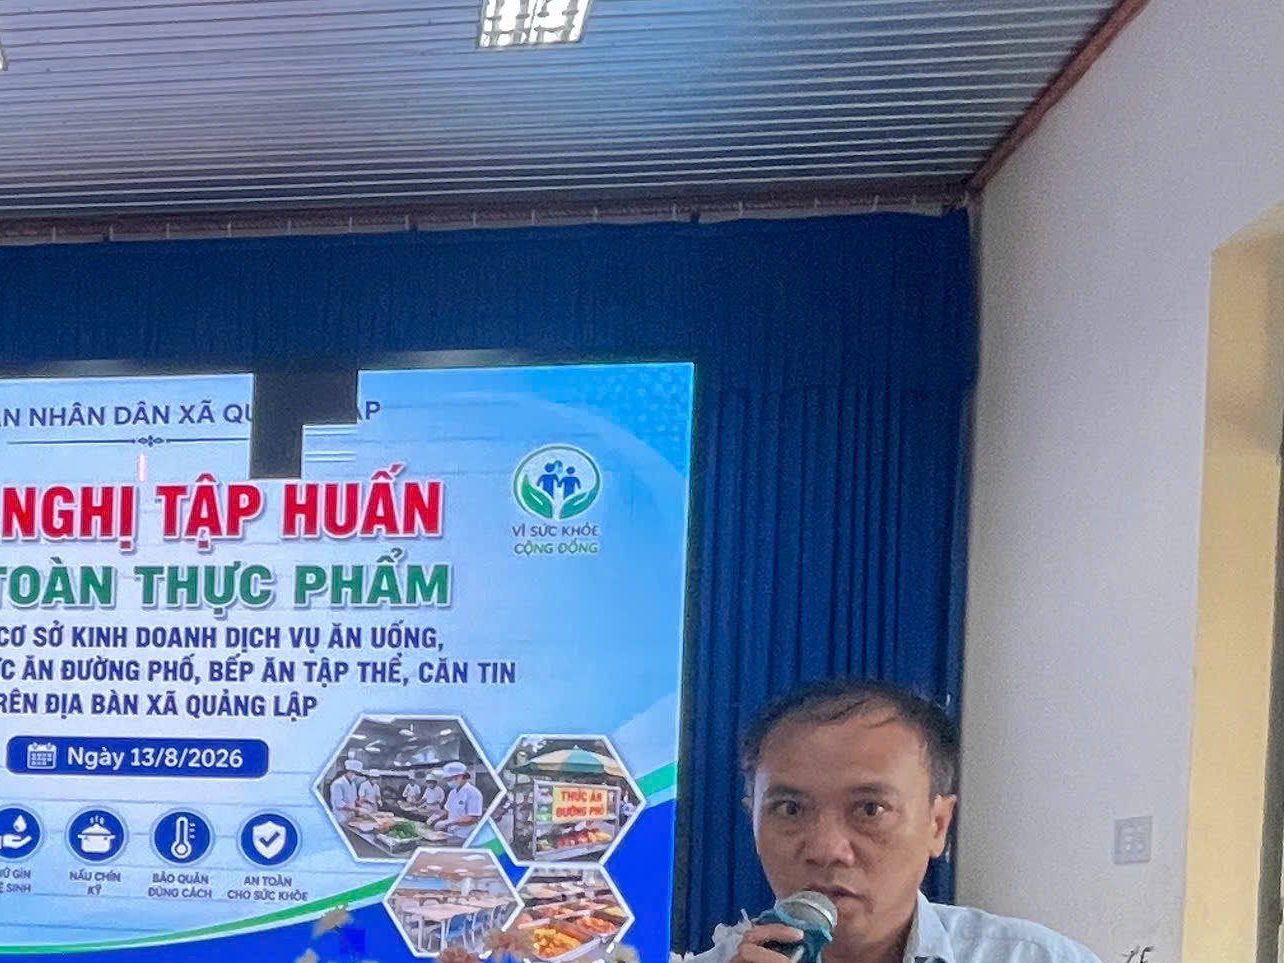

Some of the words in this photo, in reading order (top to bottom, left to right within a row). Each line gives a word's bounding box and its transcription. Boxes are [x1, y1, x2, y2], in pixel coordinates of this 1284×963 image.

[30, 401, 105, 426] NHÂN
[114, 401, 170, 425] DÂN
[178, 400, 215, 424] XÃ
[1, 485, 134, 550] NGHỊ
[156, 473, 261, 548] TẬP
[283, 464, 441, 536] HUẤN
[530, 523, 558, 537] SỨC
[514, 540, 553, 557] CỘNG
[134, 561, 273, 614] THỰC
[294, 548, 450, 605] PHẨM
[33, 620, 64, 647] SỞ
[72, 626, 127, 648] KINH
[136, 626, 216, 648] DOANH
[226, 626, 280, 653] DỊCH
[289, 627, 320, 653] VỤ
[328, 622, 362, 648] ĂN
[371, 620, 444, 651] UỐNG,
[22, 655, 54, 680] ĂN
[61, 656, 140, 681] ĐƯỜNG
[148, 653, 201, 685] PHỐ,
[208, 653, 254, 682] BẾP
[261, 657, 295, 682] ĂN
[303, 657, 349, 688] TẬP
[357, 652, 409, 686] THỂ,
[419, 657, 468, 683] CĂN
[478, 662, 516, 684] TIN
[45, 693, 84, 719] ĐỊA
[91, 689, 138, 716] BÀN
[146, 690, 178, 716] XÃ
[186, 688, 266, 718] QUẢNG
[273, 691, 317, 722] LẬP
[67, 746, 125, 771] Ngày
[130, 747, 243, 768] 13/8/2026
[6, 883, 31, 893] SINH
[244, 876, 259, 886] AN
[227, 890, 251, 900] CHO
